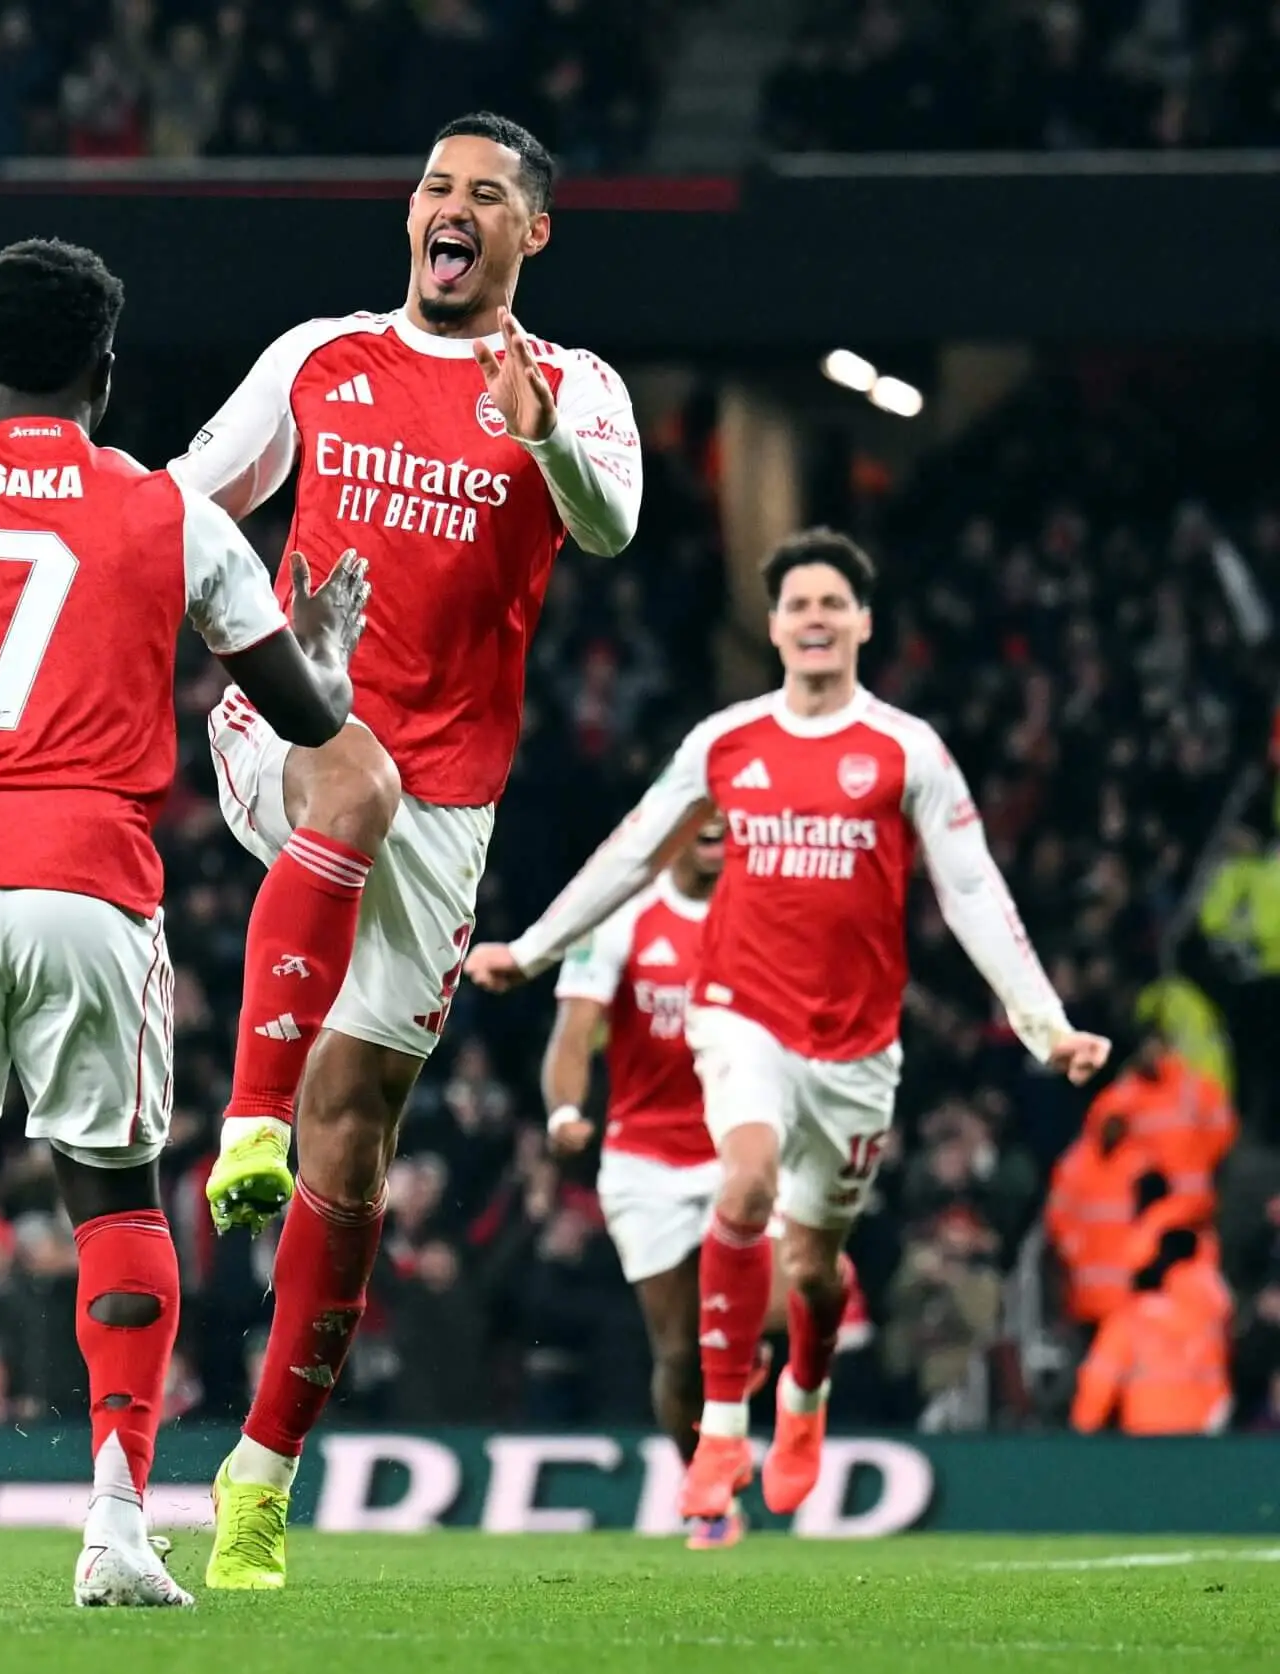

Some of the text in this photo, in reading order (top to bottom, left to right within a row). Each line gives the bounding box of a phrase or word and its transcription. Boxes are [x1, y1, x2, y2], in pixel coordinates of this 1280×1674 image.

[9, 424, 62, 438] Arsenal
[316, 432, 511, 507] Emirates
[337, 484, 478, 542] FLY BETTER
[728, 808, 877, 850] Emirates
